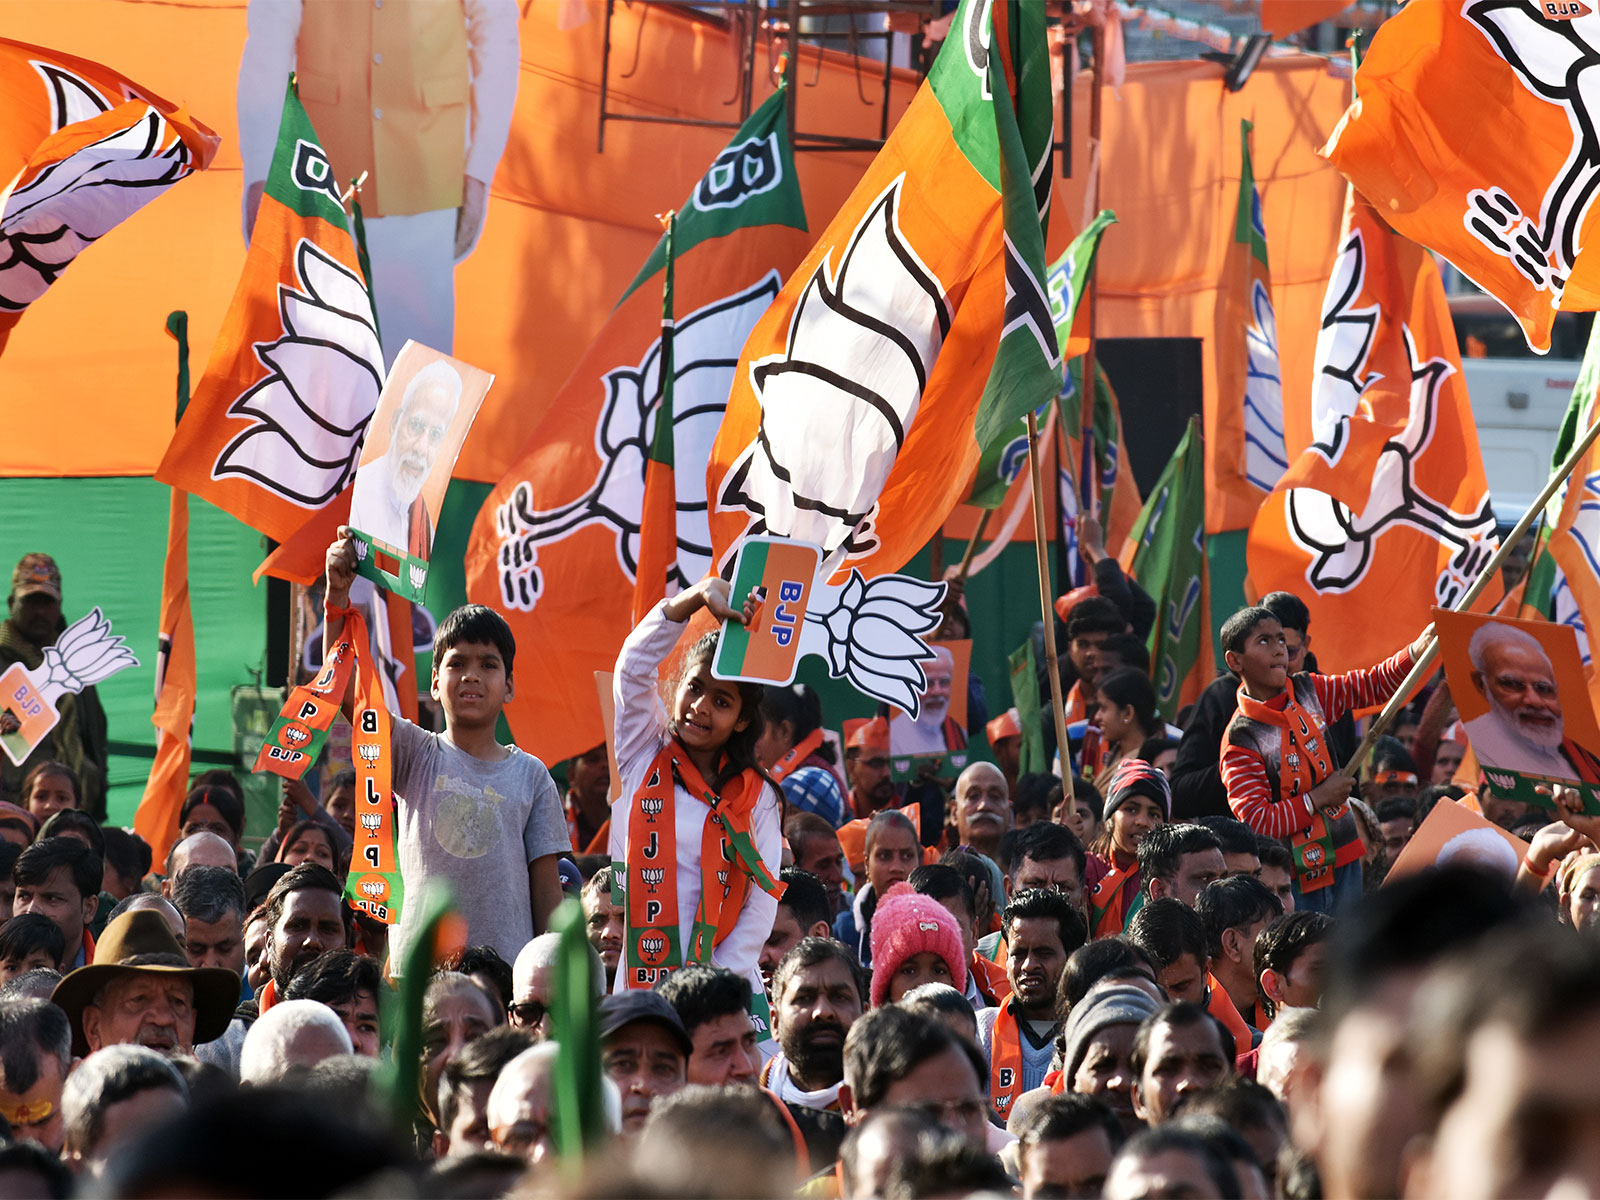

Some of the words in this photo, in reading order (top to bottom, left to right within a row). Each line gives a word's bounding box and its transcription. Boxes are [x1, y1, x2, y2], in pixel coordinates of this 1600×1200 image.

[770, 579, 804, 647] BJP
[13, 684, 42, 716] BJP
[298, 700, 319, 721] P
[269, 745, 303, 763] BJP
[642, 831, 660, 859] J
[646, 900, 663, 924] P
[999, 1067, 1014, 1089] B
